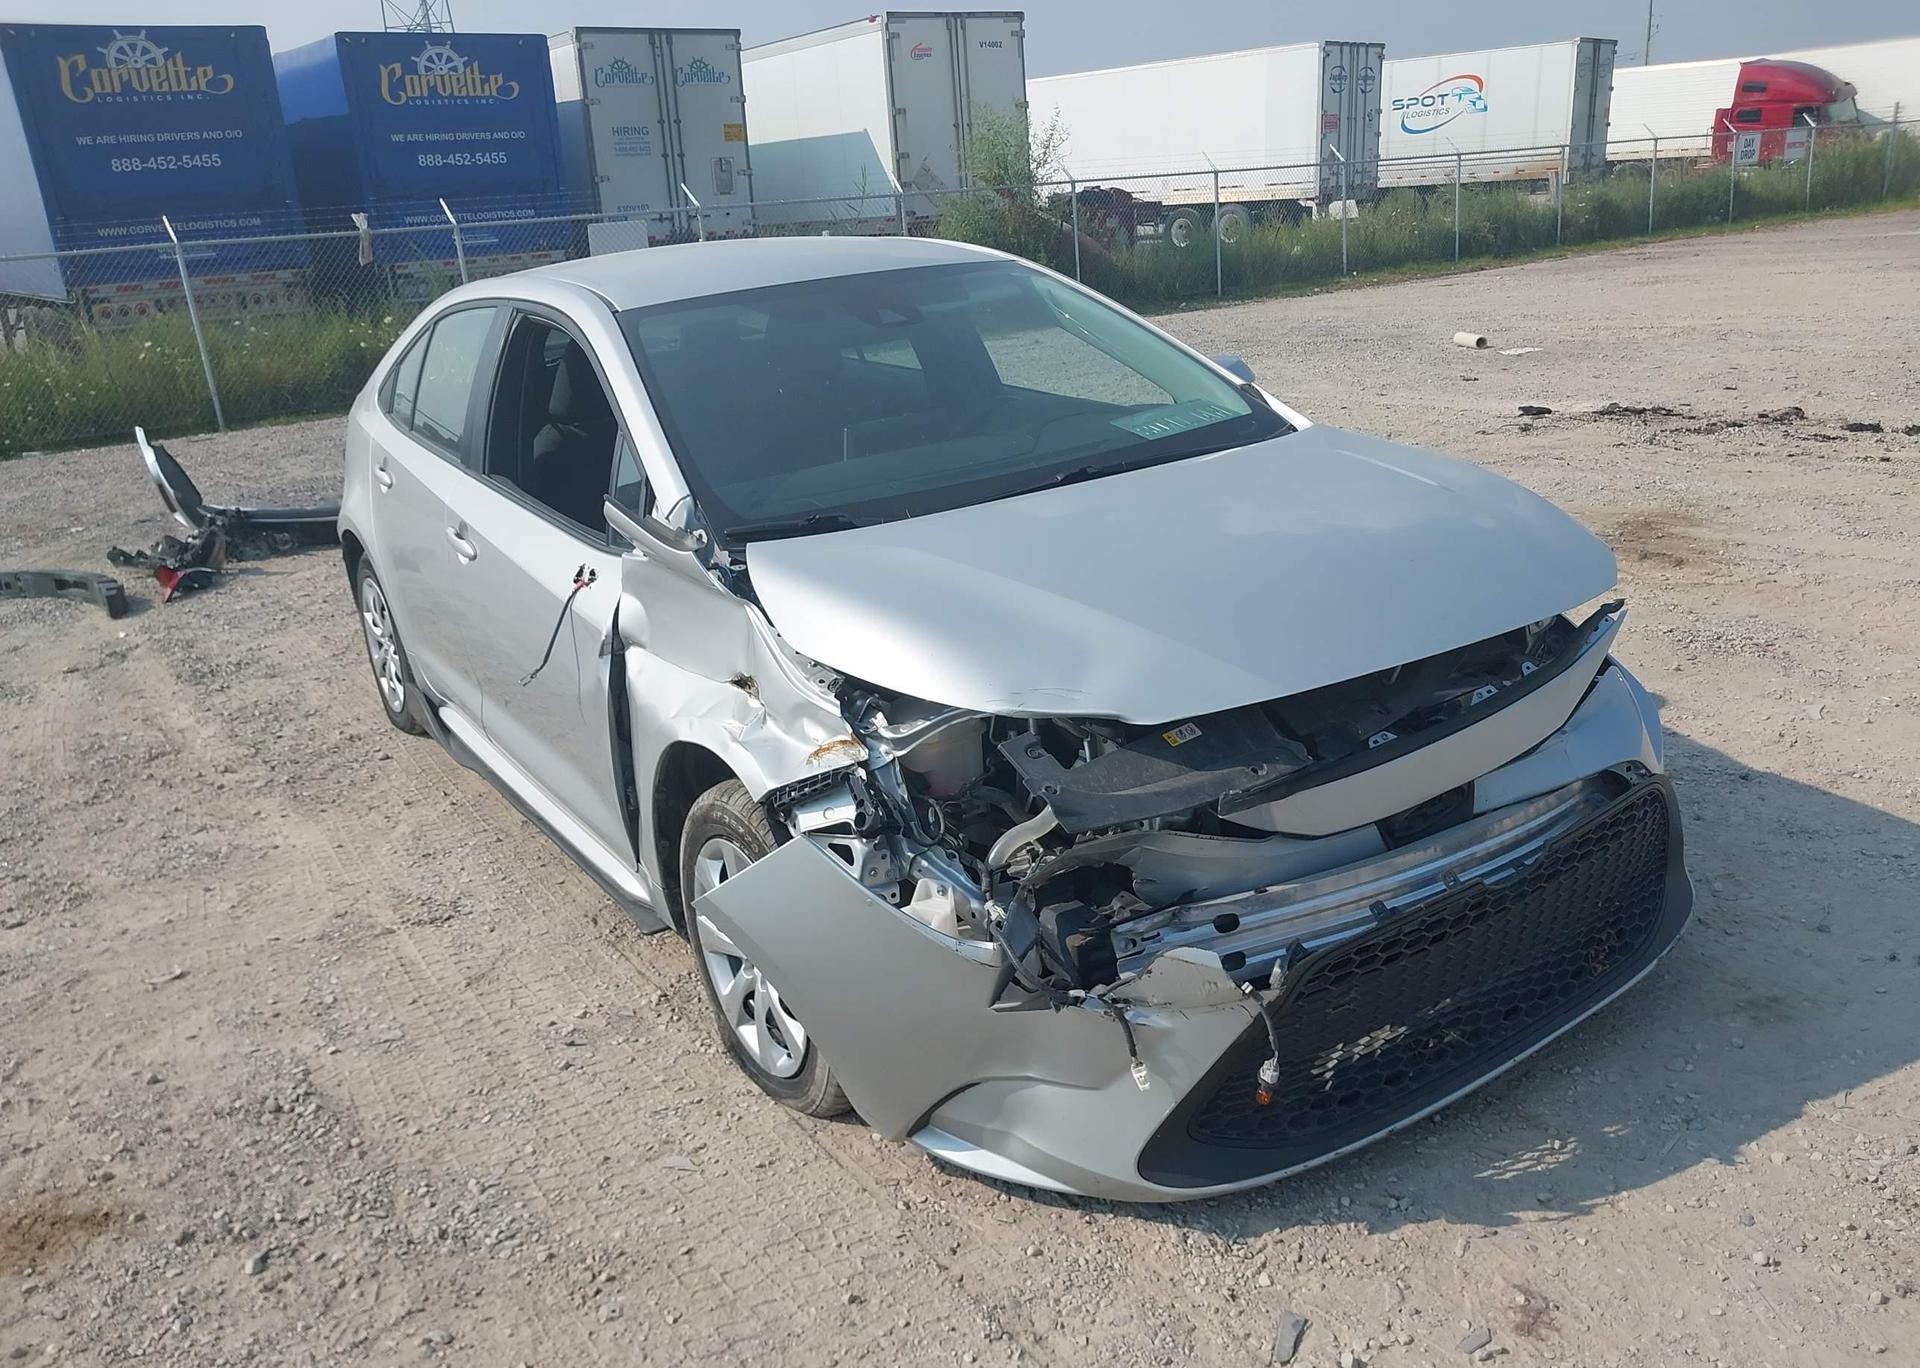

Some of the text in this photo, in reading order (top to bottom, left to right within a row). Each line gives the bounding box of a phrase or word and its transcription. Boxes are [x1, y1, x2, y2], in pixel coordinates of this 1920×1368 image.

[57, 51, 234, 103] Corvette
[379, 60, 520, 105] Corvette
[594, 66, 655, 88] Corvette
[673, 66, 731, 88] Corvette
[97, 94, 172, 102] LOGISTICS
[1392, 93, 1450, 111] SPOT
[1405, 107, 1450, 119] LOGISTICS
[76, 136, 93, 145] WE
[96, 135, 117, 144] ARE
[119, 133, 155, 143] HIRING
[156, 131, 200, 142] DRIVERS
[202, 130, 224, 139] AND
[391, 134, 405, 142] WE
[407, 133, 424, 142] ARE
[425, 132, 455, 141] HIRING
[456, 131, 491, 140] DRIVERS
[493, 131, 510, 139] AND
[611, 126, 650, 137] HIRING
[111, 153, 222, 172] 888-452-5455
[418, 152, 507, 167] 888-452-5455
[98, 217, 262, 237] WWW.CORVETELOGISTICS.COM
